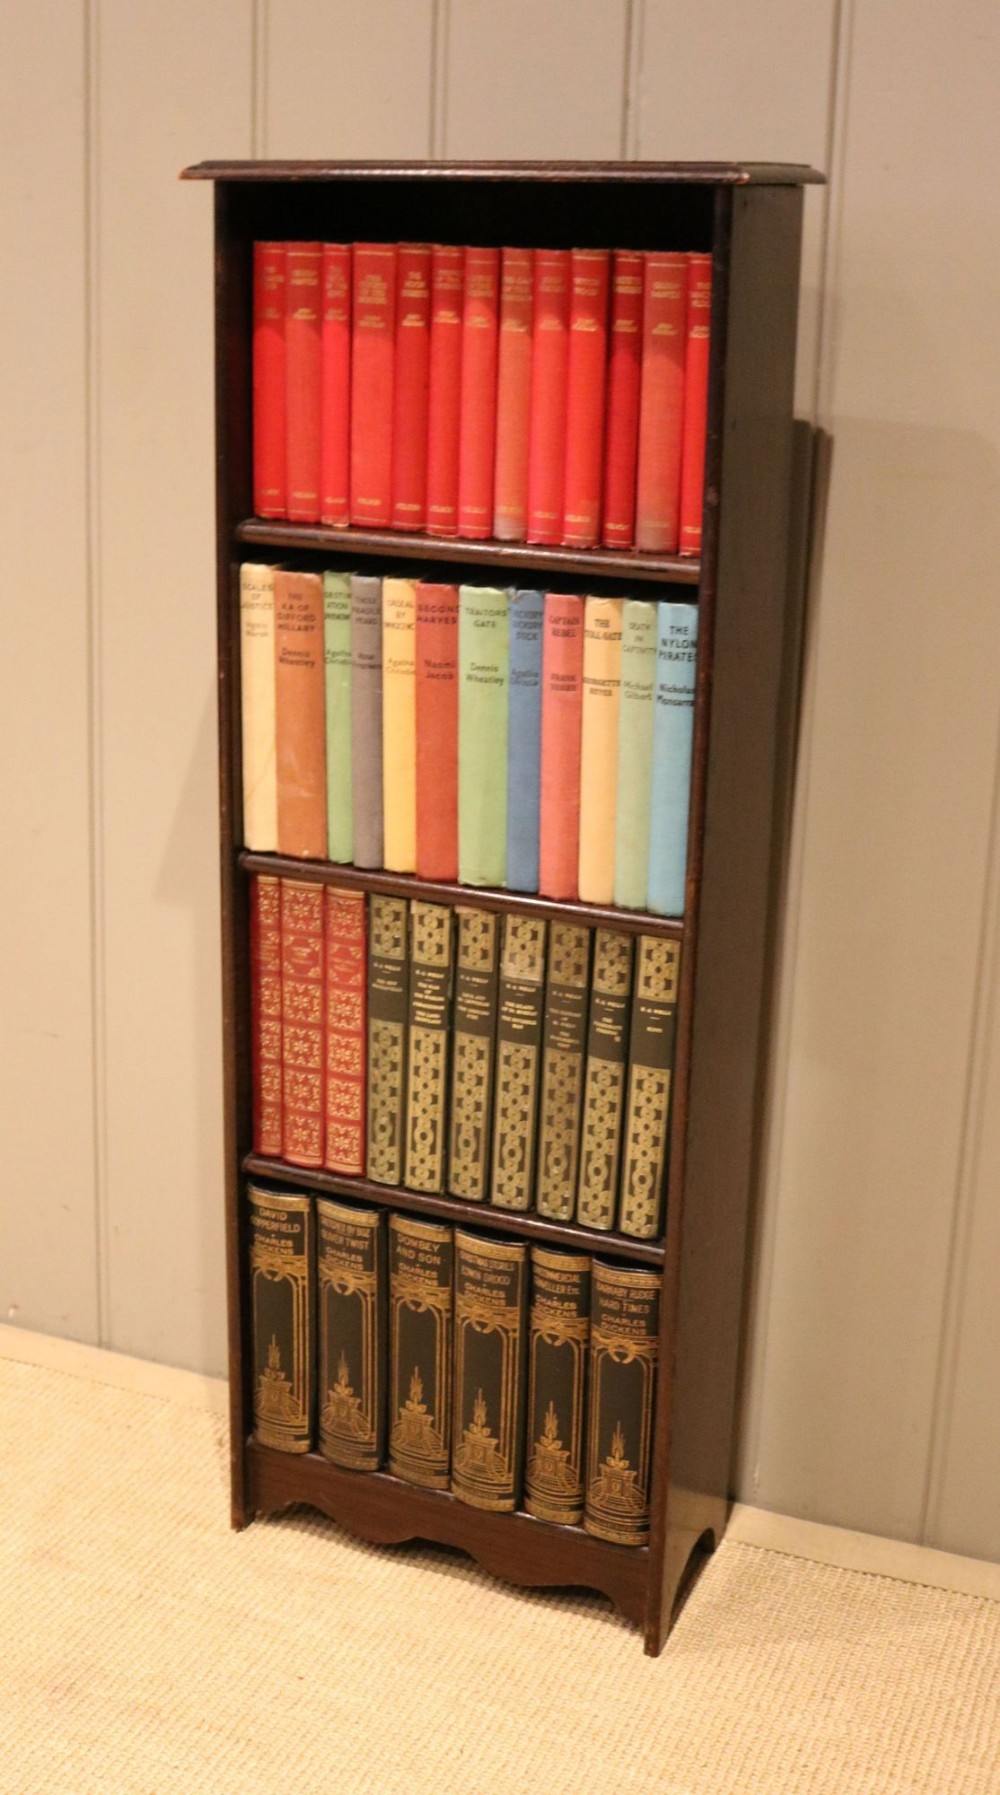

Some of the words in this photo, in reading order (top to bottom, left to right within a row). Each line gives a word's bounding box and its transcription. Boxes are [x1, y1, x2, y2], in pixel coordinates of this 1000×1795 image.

[416, 616, 457, 625] HARVES
[473, 620, 496, 629] GATE
[594, 618, 610, 628] THE
[669, 625, 689, 636] THE
[660, 638, 696, 649] NYLON
[470, 662, 499, 672] Dennis
[259, 1207, 288, 1221] DAVID
[397, 1233, 441, 1253] DOMBEY
[325, 1247, 363, 1262] CHARLES
[396, 1245, 416, 1260] AND
[418, 1252, 441, 1265] SON
[398, 1262, 438, 1279] CHARLES
[464, 1282, 506, 1299] CHARLES
[534, 1294, 578, 1310] CHARLES
[622, 1301, 650, 1314] TIMES
[600, 1314, 647, 1328] CHARLES
[600, 1321, 647, 1336] DICKENS
